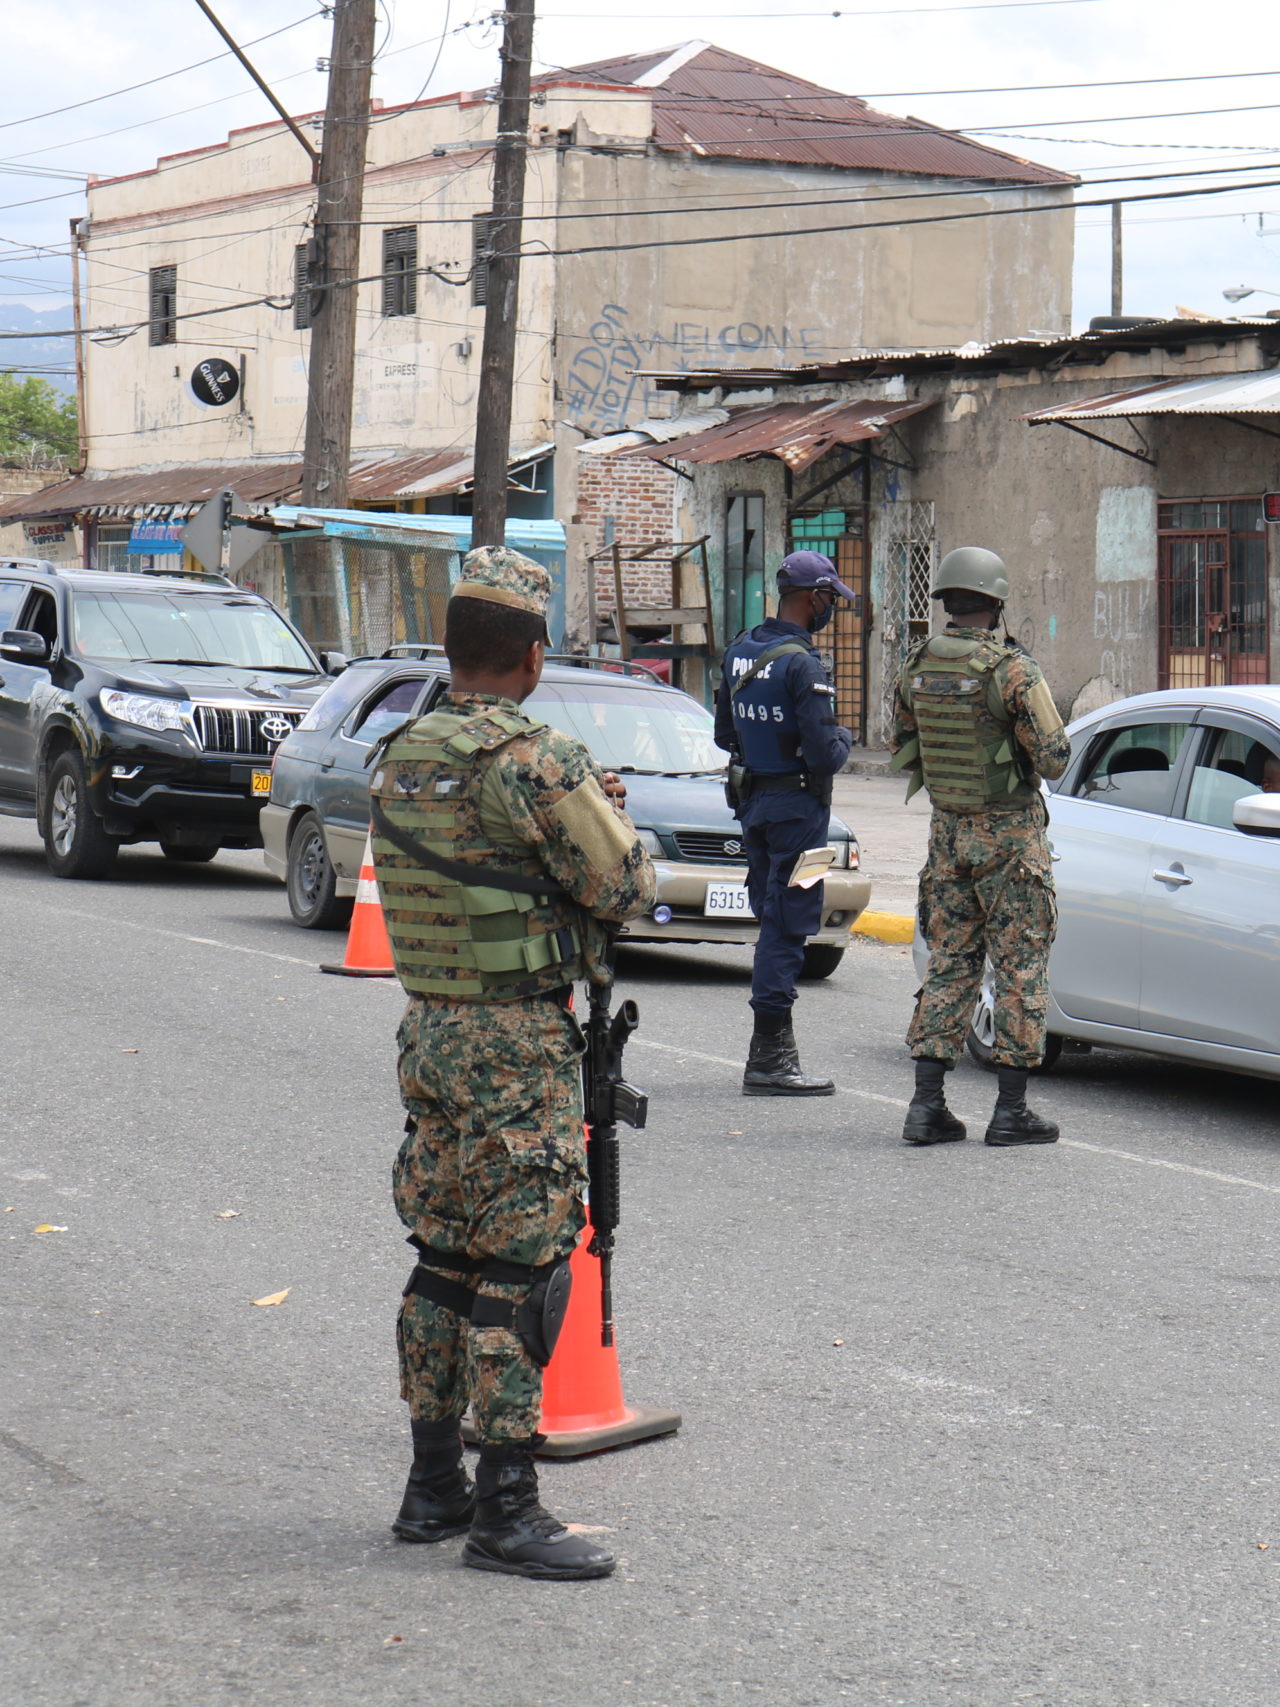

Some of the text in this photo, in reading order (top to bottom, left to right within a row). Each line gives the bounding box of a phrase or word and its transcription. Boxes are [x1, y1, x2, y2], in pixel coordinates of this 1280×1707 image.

[638, 322, 824, 357] WELCOME
[200, 363, 225, 402] GUINNESS
[32, 533, 66, 545] SUPPLIES
[254, 775, 269, 790] 20
[709, 891, 745, 910] 6315
